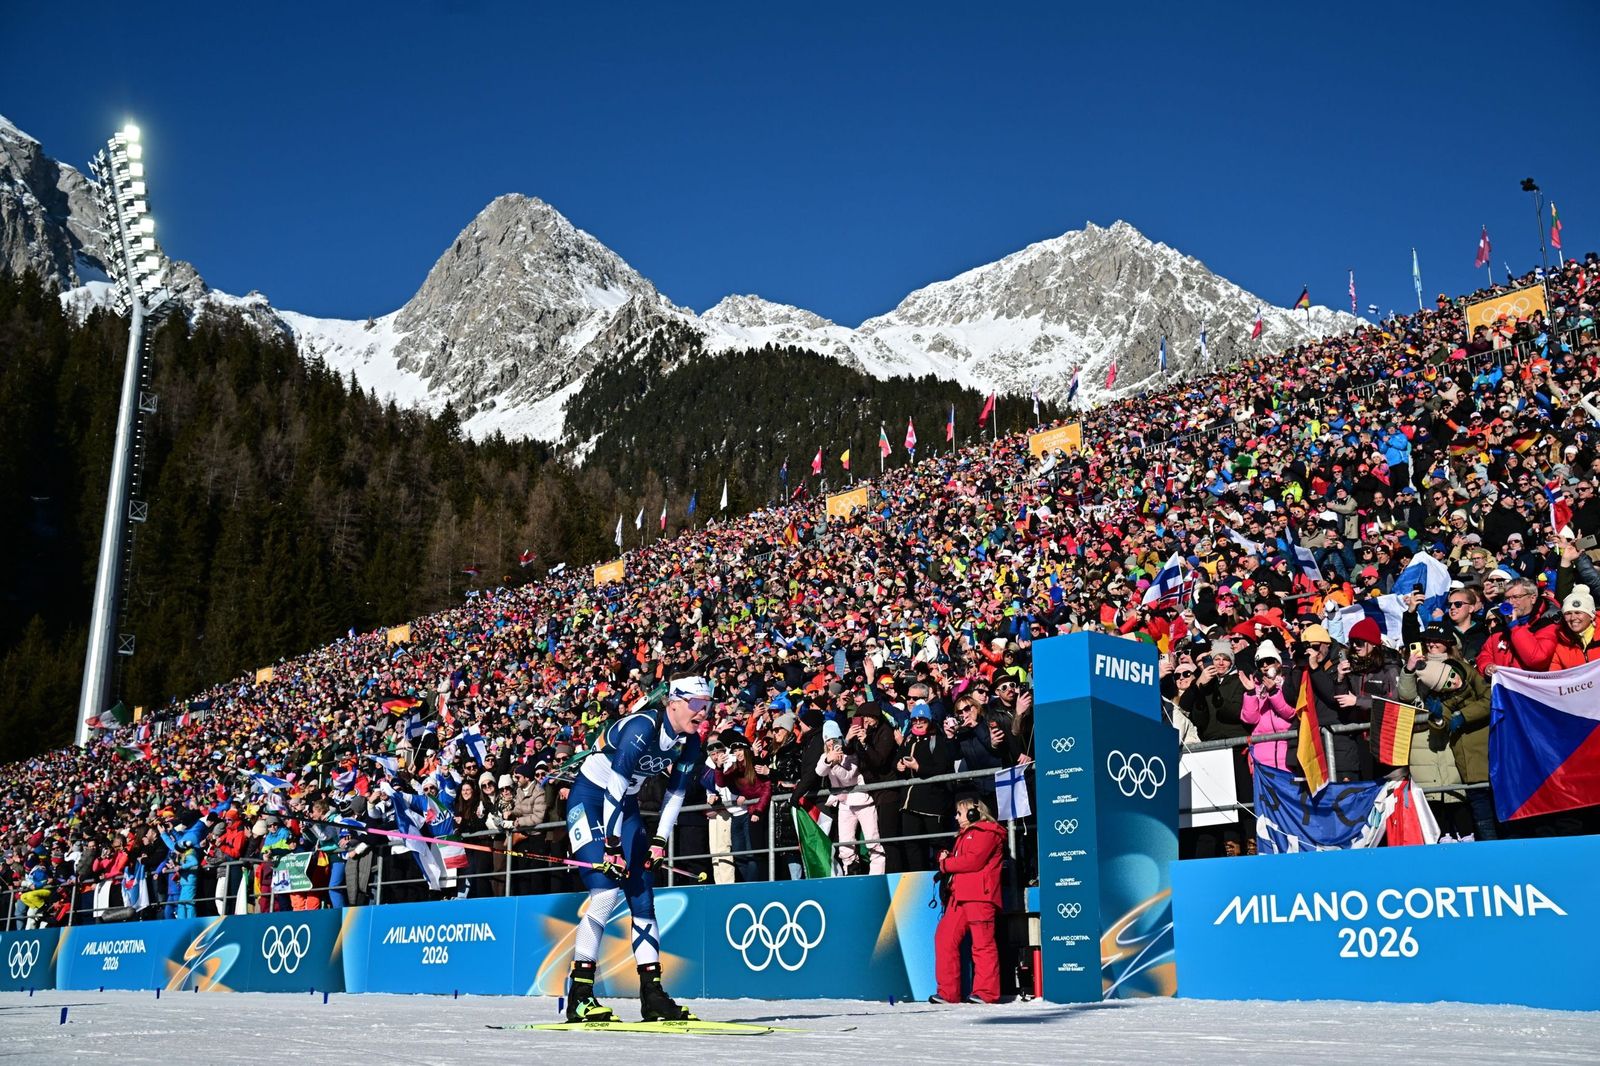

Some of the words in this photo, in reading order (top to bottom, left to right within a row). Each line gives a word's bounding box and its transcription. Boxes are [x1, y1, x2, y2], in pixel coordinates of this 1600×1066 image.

[1095, 654, 1154, 686] FINISH
[1558, 680, 1594, 696] Lucce
[574, 828, 582, 842] 6
[1214, 891, 1369, 925] MILANO
[1376, 884, 1568, 920] CORTINA
[382, 925, 436, 944] MILANO
[437, 922, 496, 943] CORTINA
[1339, 927, 1419, 958] 2026
[82, 941, 114, 956] MILANO
[114, 939, 146, 954] CORTINA
[421, 945, 449, 964] 2026
[102, 956, 119, 971] 2026
